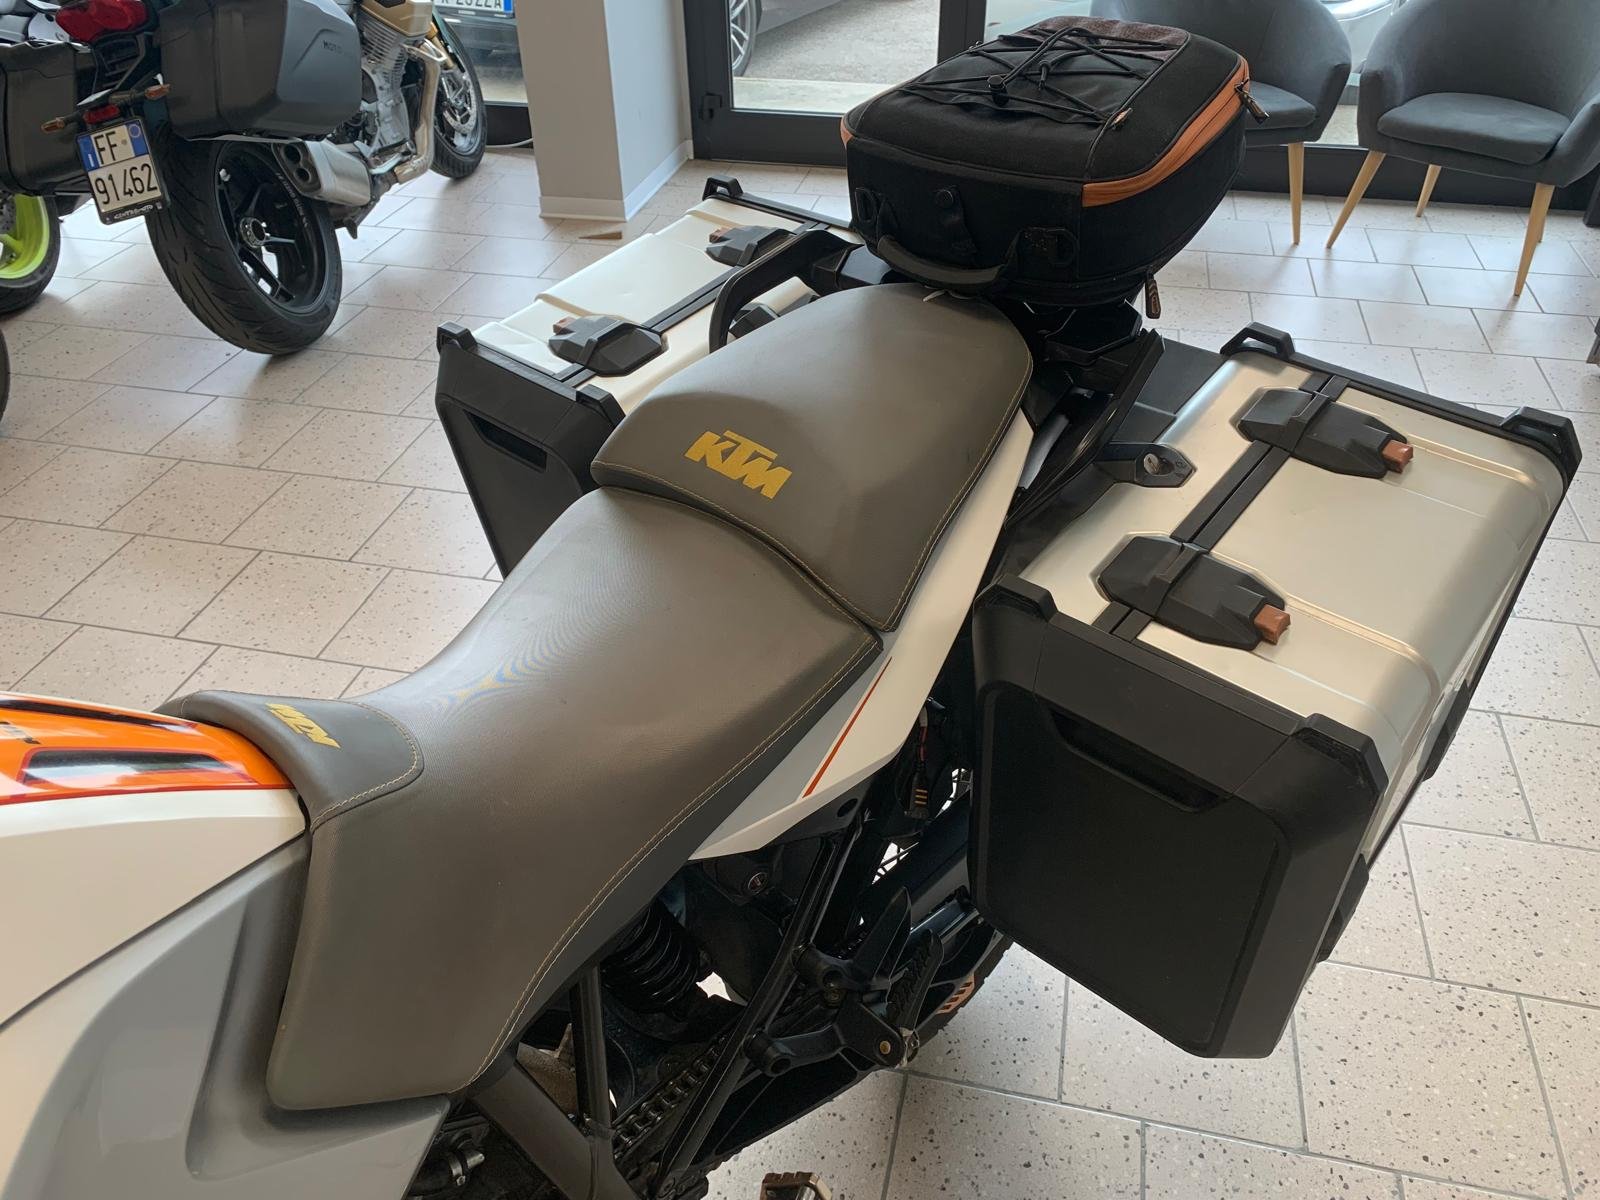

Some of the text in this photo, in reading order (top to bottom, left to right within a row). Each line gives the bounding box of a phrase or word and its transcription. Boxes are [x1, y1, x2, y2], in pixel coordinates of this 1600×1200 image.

[94, 131, 117, 165] FF
[94, 163, 158, 205] 91462
[684, 430, 793, 500] KTM
